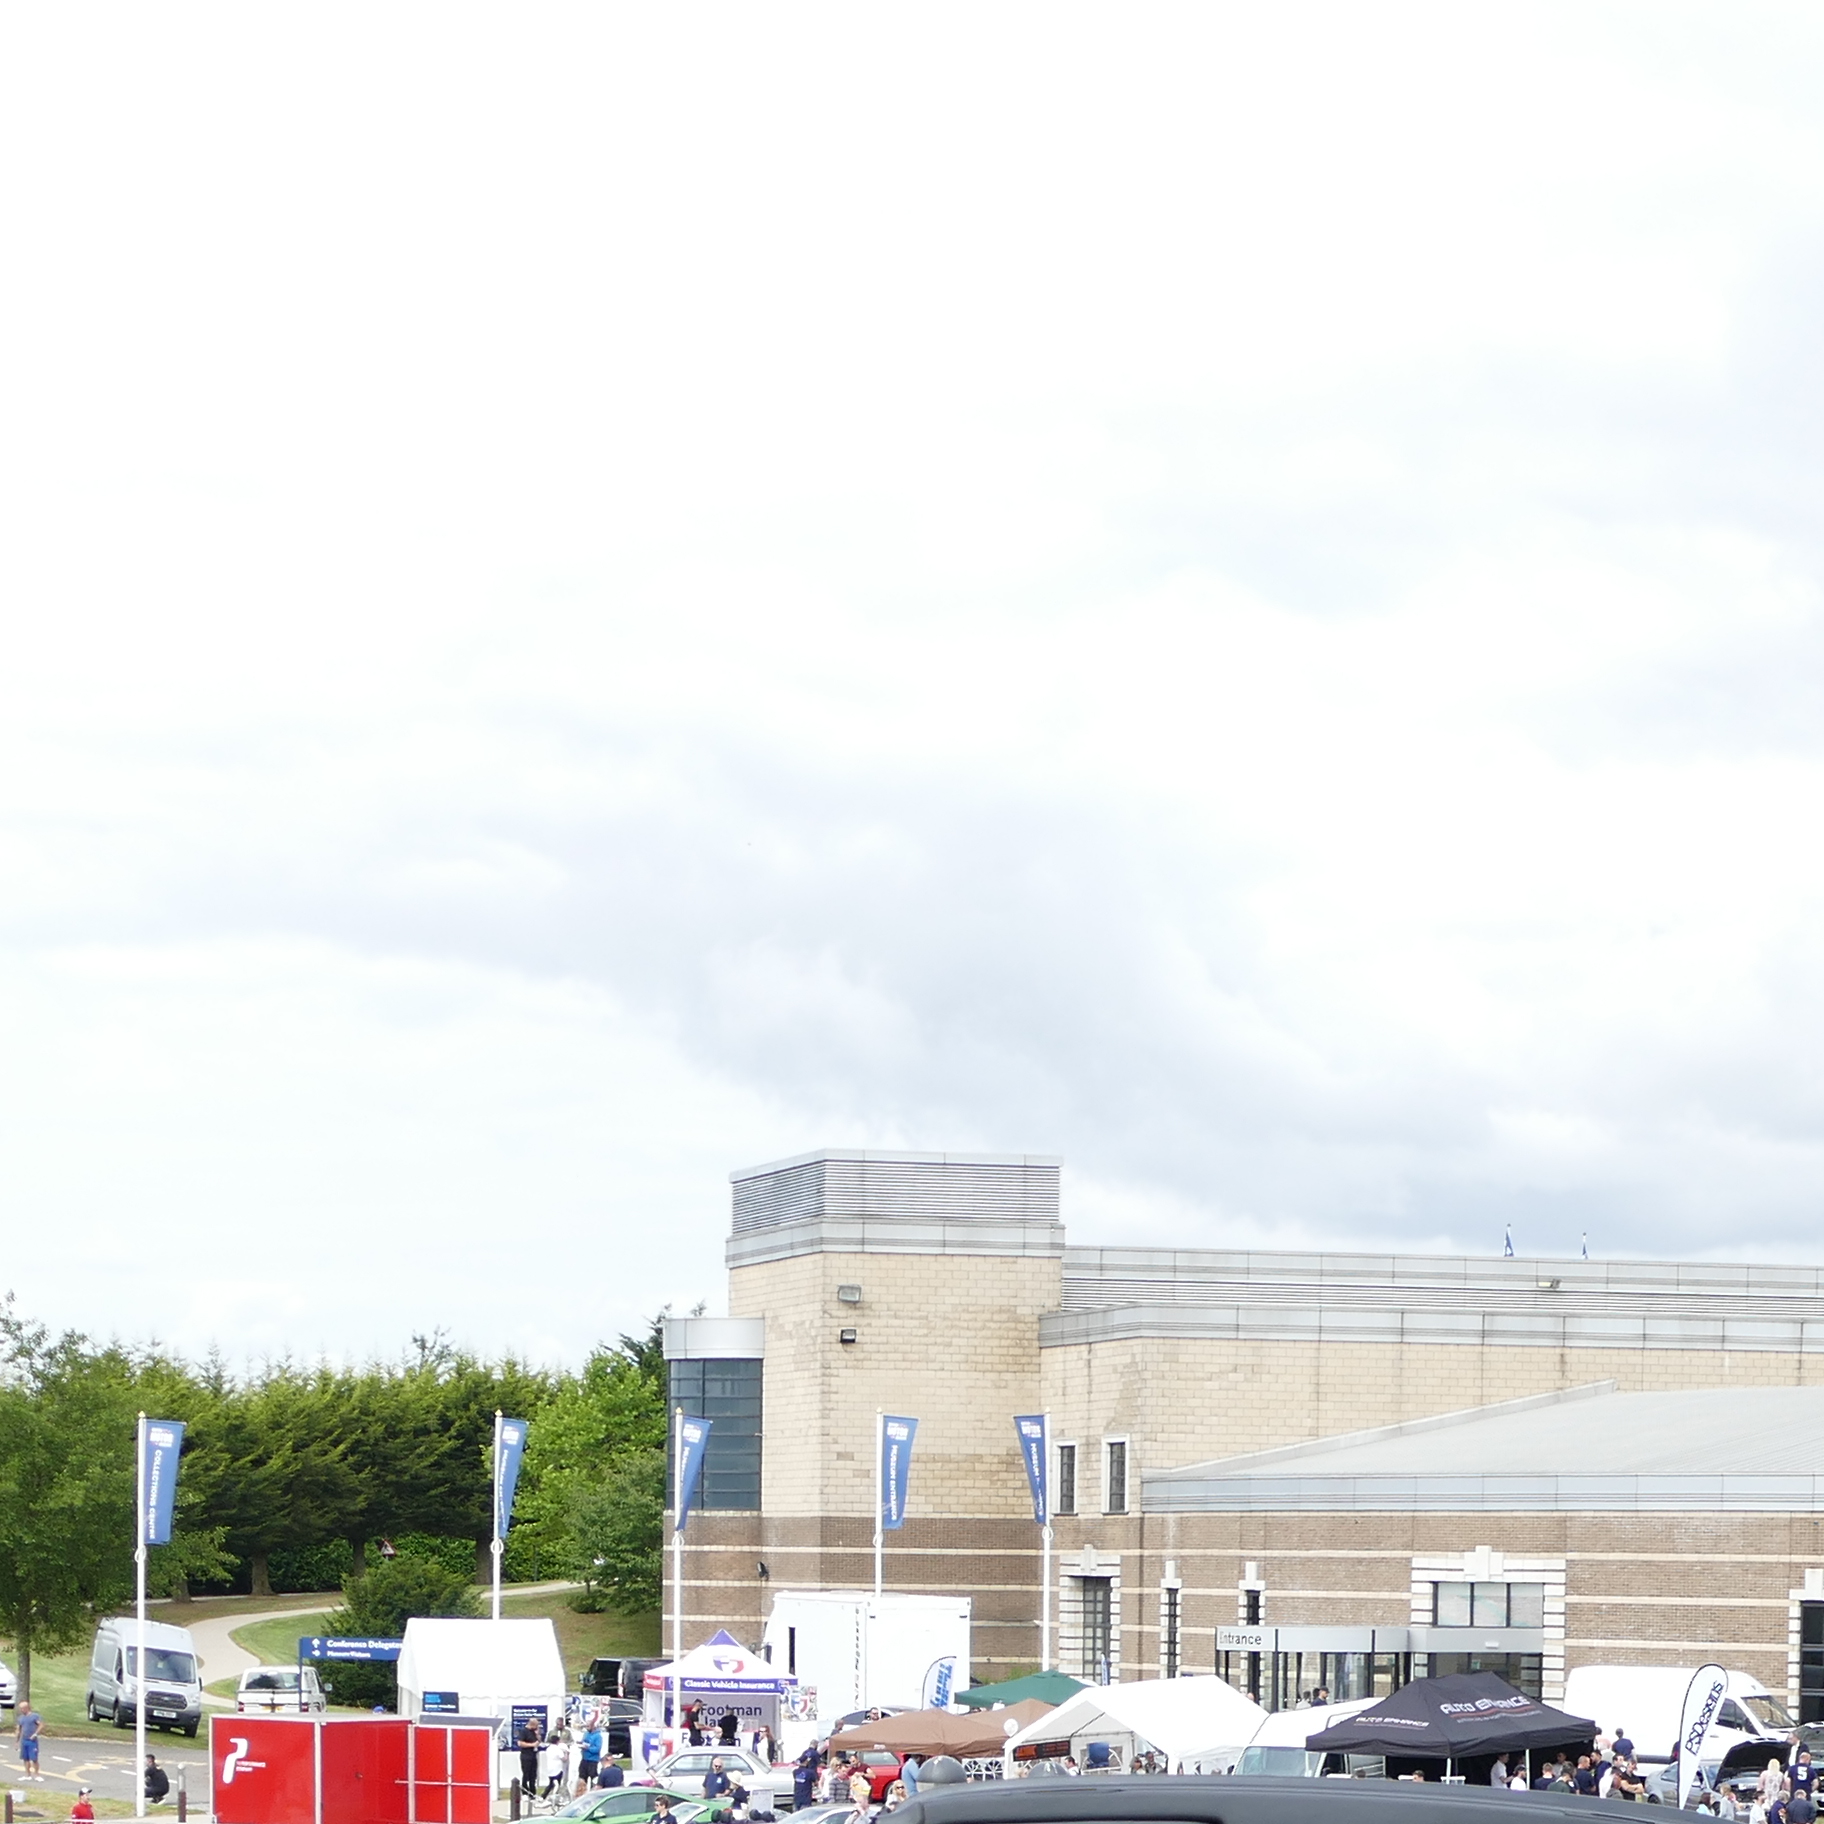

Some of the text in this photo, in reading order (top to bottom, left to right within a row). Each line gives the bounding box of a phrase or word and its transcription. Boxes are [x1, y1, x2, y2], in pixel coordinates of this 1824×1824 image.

[150, 1449, 162, 1507] COLLECTIONS
[326, 1640, 367, 1649] Conference
[1219, 1631, 1262, 1645] Entrance
[684, 1679, 775, 1690] Classic Vehicle Insurance
[1440, 1702, 1475, 1714] AUTO
[1798, 1766, 1808, 1780] 5
